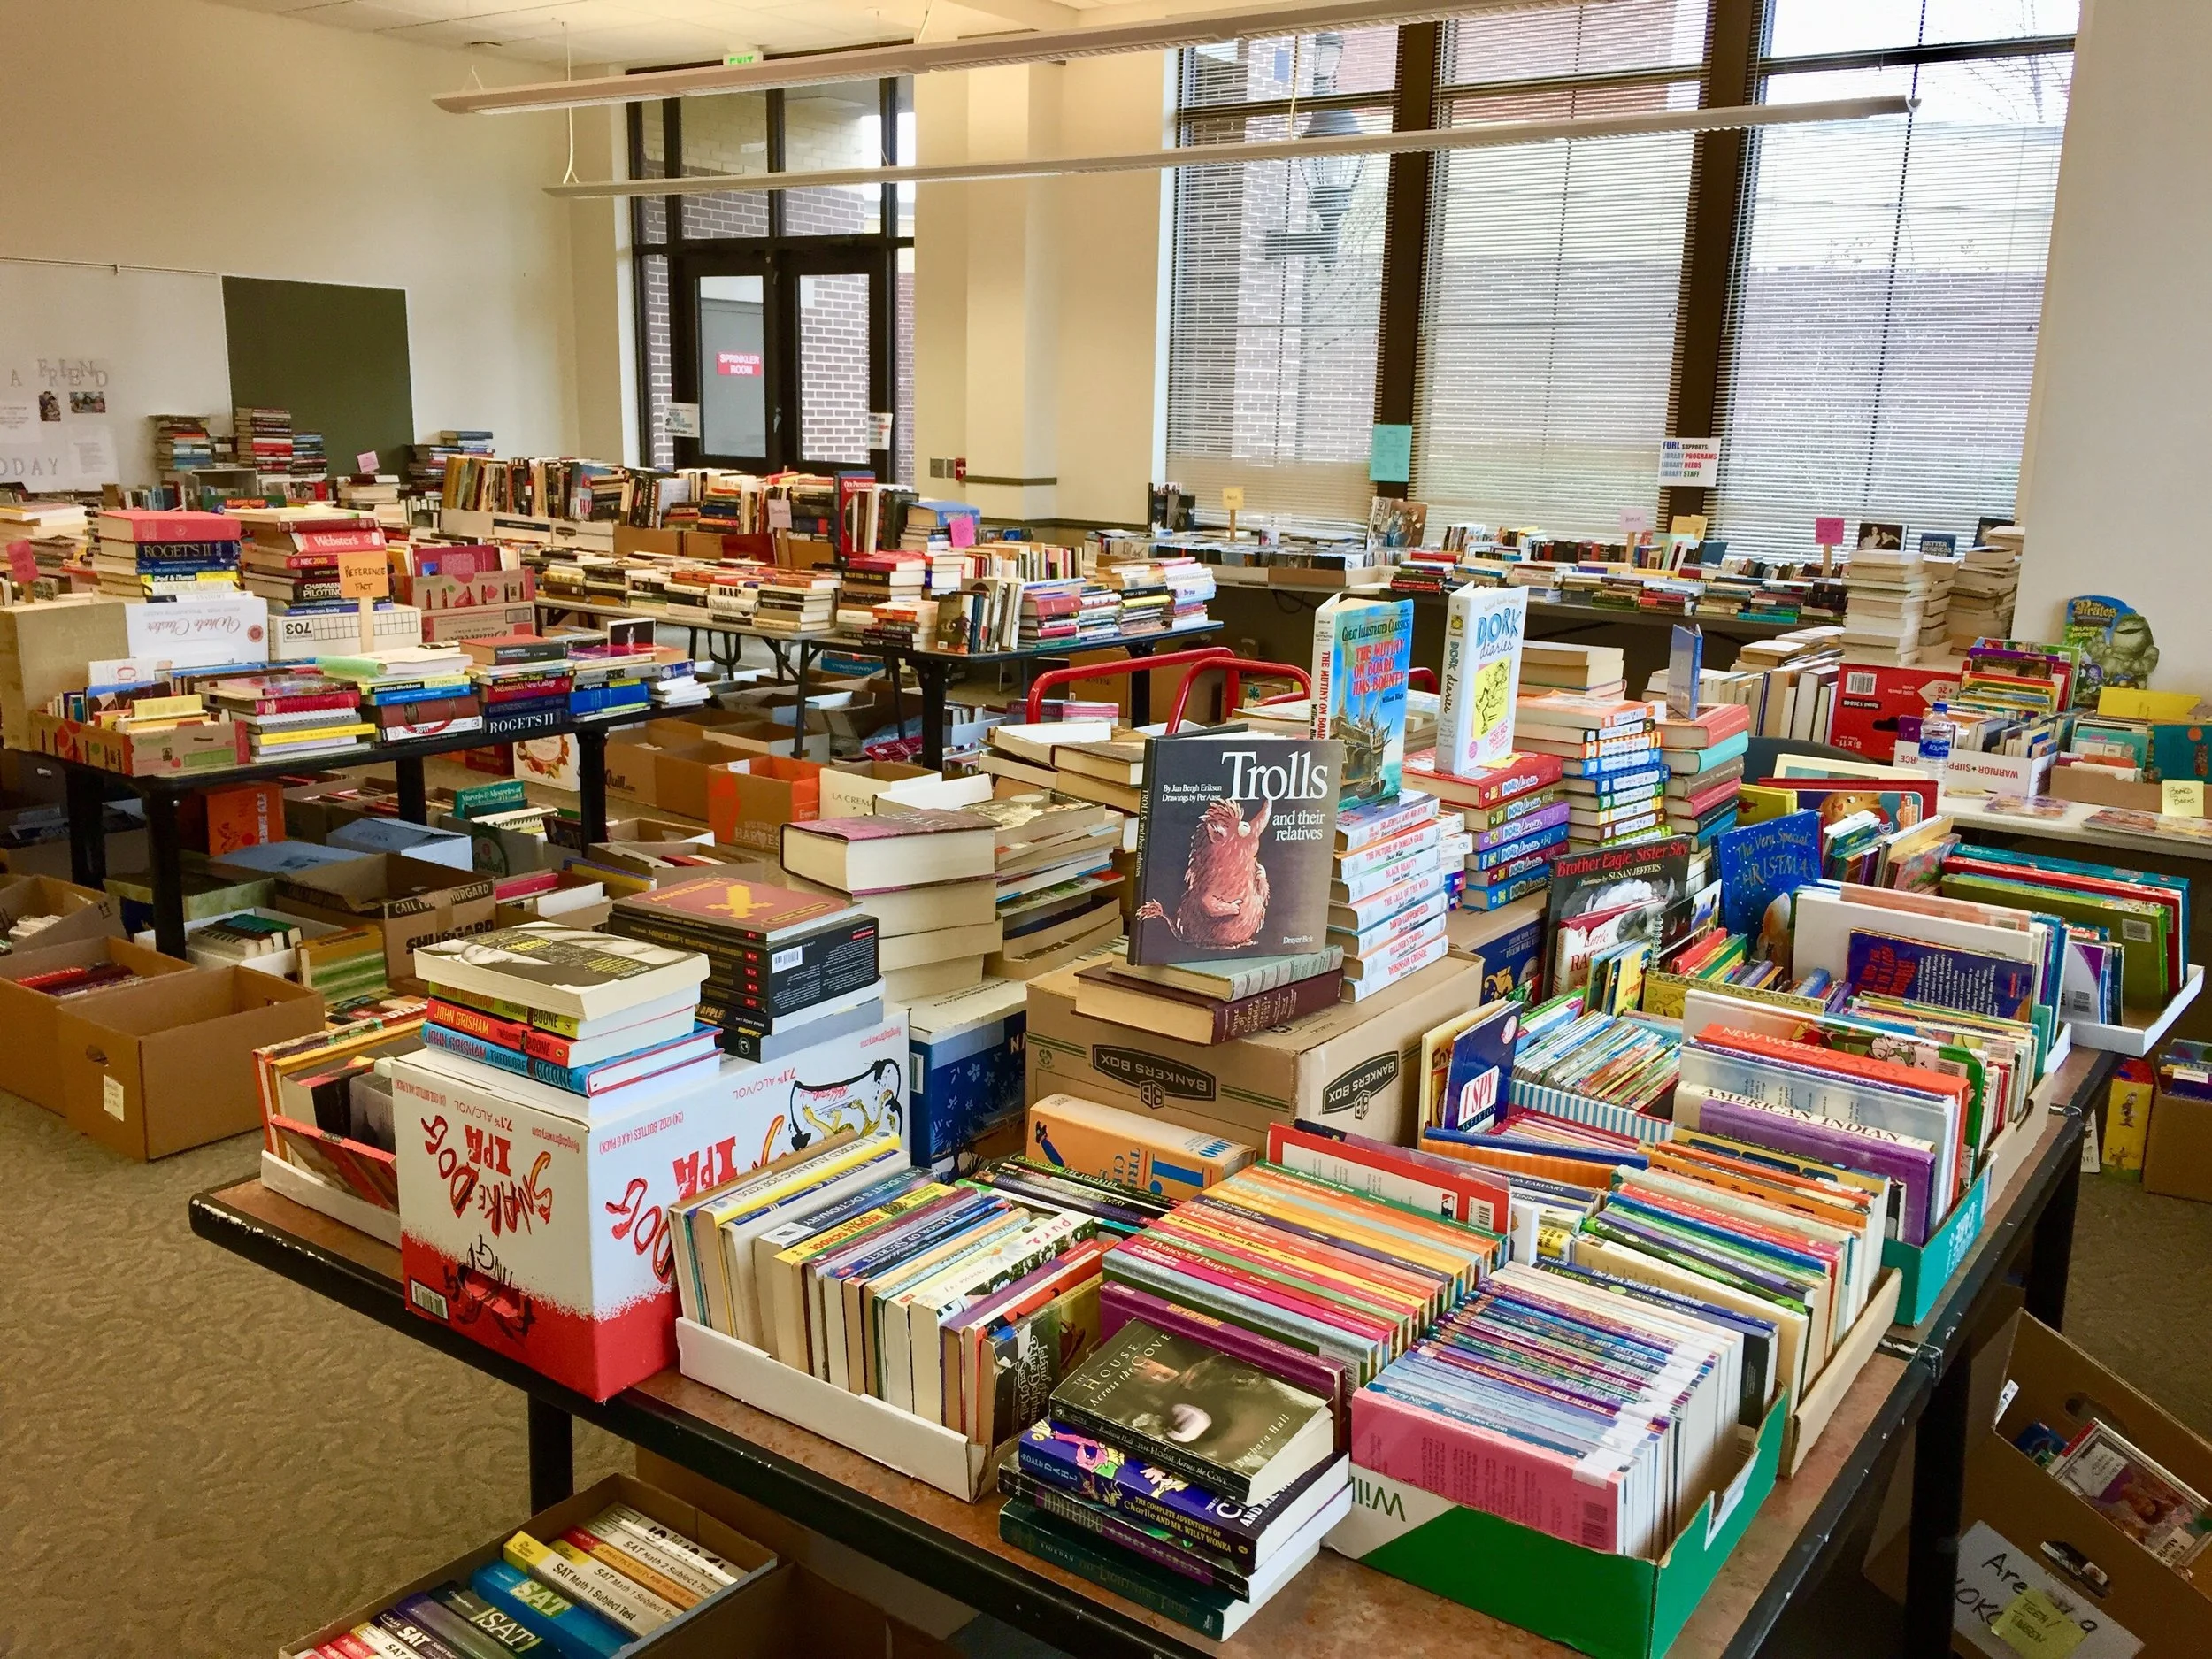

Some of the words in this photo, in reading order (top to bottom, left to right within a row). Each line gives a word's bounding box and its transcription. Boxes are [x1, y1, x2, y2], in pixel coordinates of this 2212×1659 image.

[720, 354, 760, 364] SPRINKLER
[730, 365, 753, 374] ROOM
[11, 369, 23, 387] A
[37, 358, 109, 388] FRIEND
[1663, 441, 1680, 449] FURL
[143, 542, 201, 557] ROGET'S
[313, 534, 359, 547] Webster's
[344, 565, 386, 578] REFERENCE
[355, 582, 373, 591] FACT
[147, 618, 191, 636] Cluster
[285, 623, 312, 635] 703
[1476, 608, 1521, 648] DORK
[1374, 638, 1405, 658] MUTINY
[1449, 641, 1460, 671] DORK
[1479, 641, 1514, 660] diaries
[1368, 657, 1394, 675] BOARD
[1320, 670, 1330, 703] MUTINY
[1443, 674, 1459, 714] diaries
[1319, 703, 1328, 716] ON
[489, 716, 542, 734] ROGET'S
[544, 712, 555, 725] II
[1220, 750, 1328, 801] Trolls
[1978, 764, 2019, 779] WARRIOR
[832, 792, 842, 801] LA
[1162, 794, 1189, 803] Drawings
[1163, 784, 1171, 794] By
[1171, 784, 1182, 793] Jan
[1182, 784, 1200, 795] Bergh
[2172, 796, 2195, 805] BOOKS
[1272, 810, 1295, 826] and
[1297, 809, 1325, 825] their
[1275, 826, 1323, 841] relatives
[1557, 854, 1600, 877] Brother
[1635, 842, 1667, 863] Sister
[1669, 839, 1688, 858] Sky
[1608, 868, 1633, 881] SUSAN
[1633, 863, 1662, 876] JEFFERS
[395, 902, 415, 915] CALL
[1584, 929, 1609, 948] Little
[533, 1008, 558, 1028] BOONE
[1239, 1016, 1248, 1025] of
[1243, 1003, 1254, 1033] Green
[434, 1005, 455, 1024] JOHN
[456, 1011, 489, 1035] GRISHAM
[526, 1036, 551, 1056] BOONE
[1723, 1026, 1766, 1042] NEW
[1766, 1034, 1828, 1056] WORLD
[425, 1028, 447, 1047] JOHN
[449, 1035, 487, 1059] GRISHAM
[490, 1049, 526, 1071] THEODORE
[535, 1061, 574, 1089] BOONE
[1101, 1052, 1132, 1071] BOX
[1136, 1063, 1208, 1092] BANKERS
[1327, 1080, 1351, 1105] BOX
[1352, 1061, 1397, 1091] BANKERS
[1814, 1065, 1904, 1092] REFERENCE
[733, 1074, 776, 1099] ALC/VOL
[454, 1100, 494, 1122] ALC/VOL
[1701, 1087, 1814, 1122] AMERICAN
[1821, 1117, 1901, 1143] INDIAN
[465, 1124, 512, 1177] IPA
[672, 1135, 738, 1202] IPA
[737, 1185, 757, 1199] KIDS
[760, 1178, 779, 1189] FOR
[861, 1171, 915, 1201] STUDENT'S
[477, 1150, 554, 1240] SNAKE
[803, 1194, 864, 1227] DICTIONARY
[1704, 1208, 1727, 1218] WENT
[849, 1213, 884, 1234] MIDDLE
[810, 1229, 849, 1252] SCHOOL
[906, 1231, 921, 1242] OF
[1245, 1240, 1270, 1253] Holmes
[1197, 1256, 1238, 1275] Pauper
[1540, 1255, 1569, 1266] BELLAIRS
[1592, 1269, 1606, 1279] The
[1606, 1273, 1625, 1284] Dark
[1166, 1302, 1224, 1328] SUPERFUDGE
[1632, 1293, 1654, 1302] INTO
[1674, 1305, 1699, 1315] WILD
[1256, 1336, 1282, 1348] WEEKLY
[1027, 1335, 1039, 1373] Blue
[1037, 1344, 1052, 1381] Island
[1082, 1343, 1141, 1391] HOUSE
[1089, 1379, 1120, 1407] Across
[1131, 1333, 1171, 1371] COVE
[1463, 1414, 1486, 1425] Jones
[1235, 1433, 1271, 1468] Barbara
[1269, 1413, 1291, 1435] Hall
[1149, 1445, 1176, 1466] HOUSE
[1175, 1458, 1196, 1472] Across
[1195, 1465, 1207, 1476] the
[1206, 1469, 1230, 1486] COVE
[1041, 1491, 1104, 1532] NINTENDO
[1134, 1495, 1146, 1504] THE
[1146, 1500, 1177, 1518] COMPLETE
[1176, 1509, 1211, 1533] ADVENTURES
[1211, 1528, 1222, 1538] OF
[1124, 1500, 1156, 1521] Charlie
[1156, 1514, 1171, 1526] AND
[1170, 1519, 1184, 1532] MR.
[1184, 1524, 1206, 1541] WILLY
[1204, 1534, 1232, 1552] WONKA
[1040, 1541, 1074, 1563] RIORDAN
[623, 1540, 645, 1554] SAT
[643, 1550, 662, 1565] Math
[667, 1564, 699, 1586] Subject
[698, 1582, 716, 1595] Test
[1981, 1553, 2029, 1595] Are
[553, 1563, 574, 1578] SAT
[569, 1575, 588, 1592] Math
[592, 1589, 620, 1611] Subject
[618, 1606, 637, 1621] Test
[594, 1568, 615, 1581] SAT
[612, 1578, 631, 1593] Math
[634, 1592, 664, 1613] Subject
[397, 1626, 431, 1647] SAT
[479, 1611, 535, 1647] SAT
[385, 1644, 404, 1657] SAT
